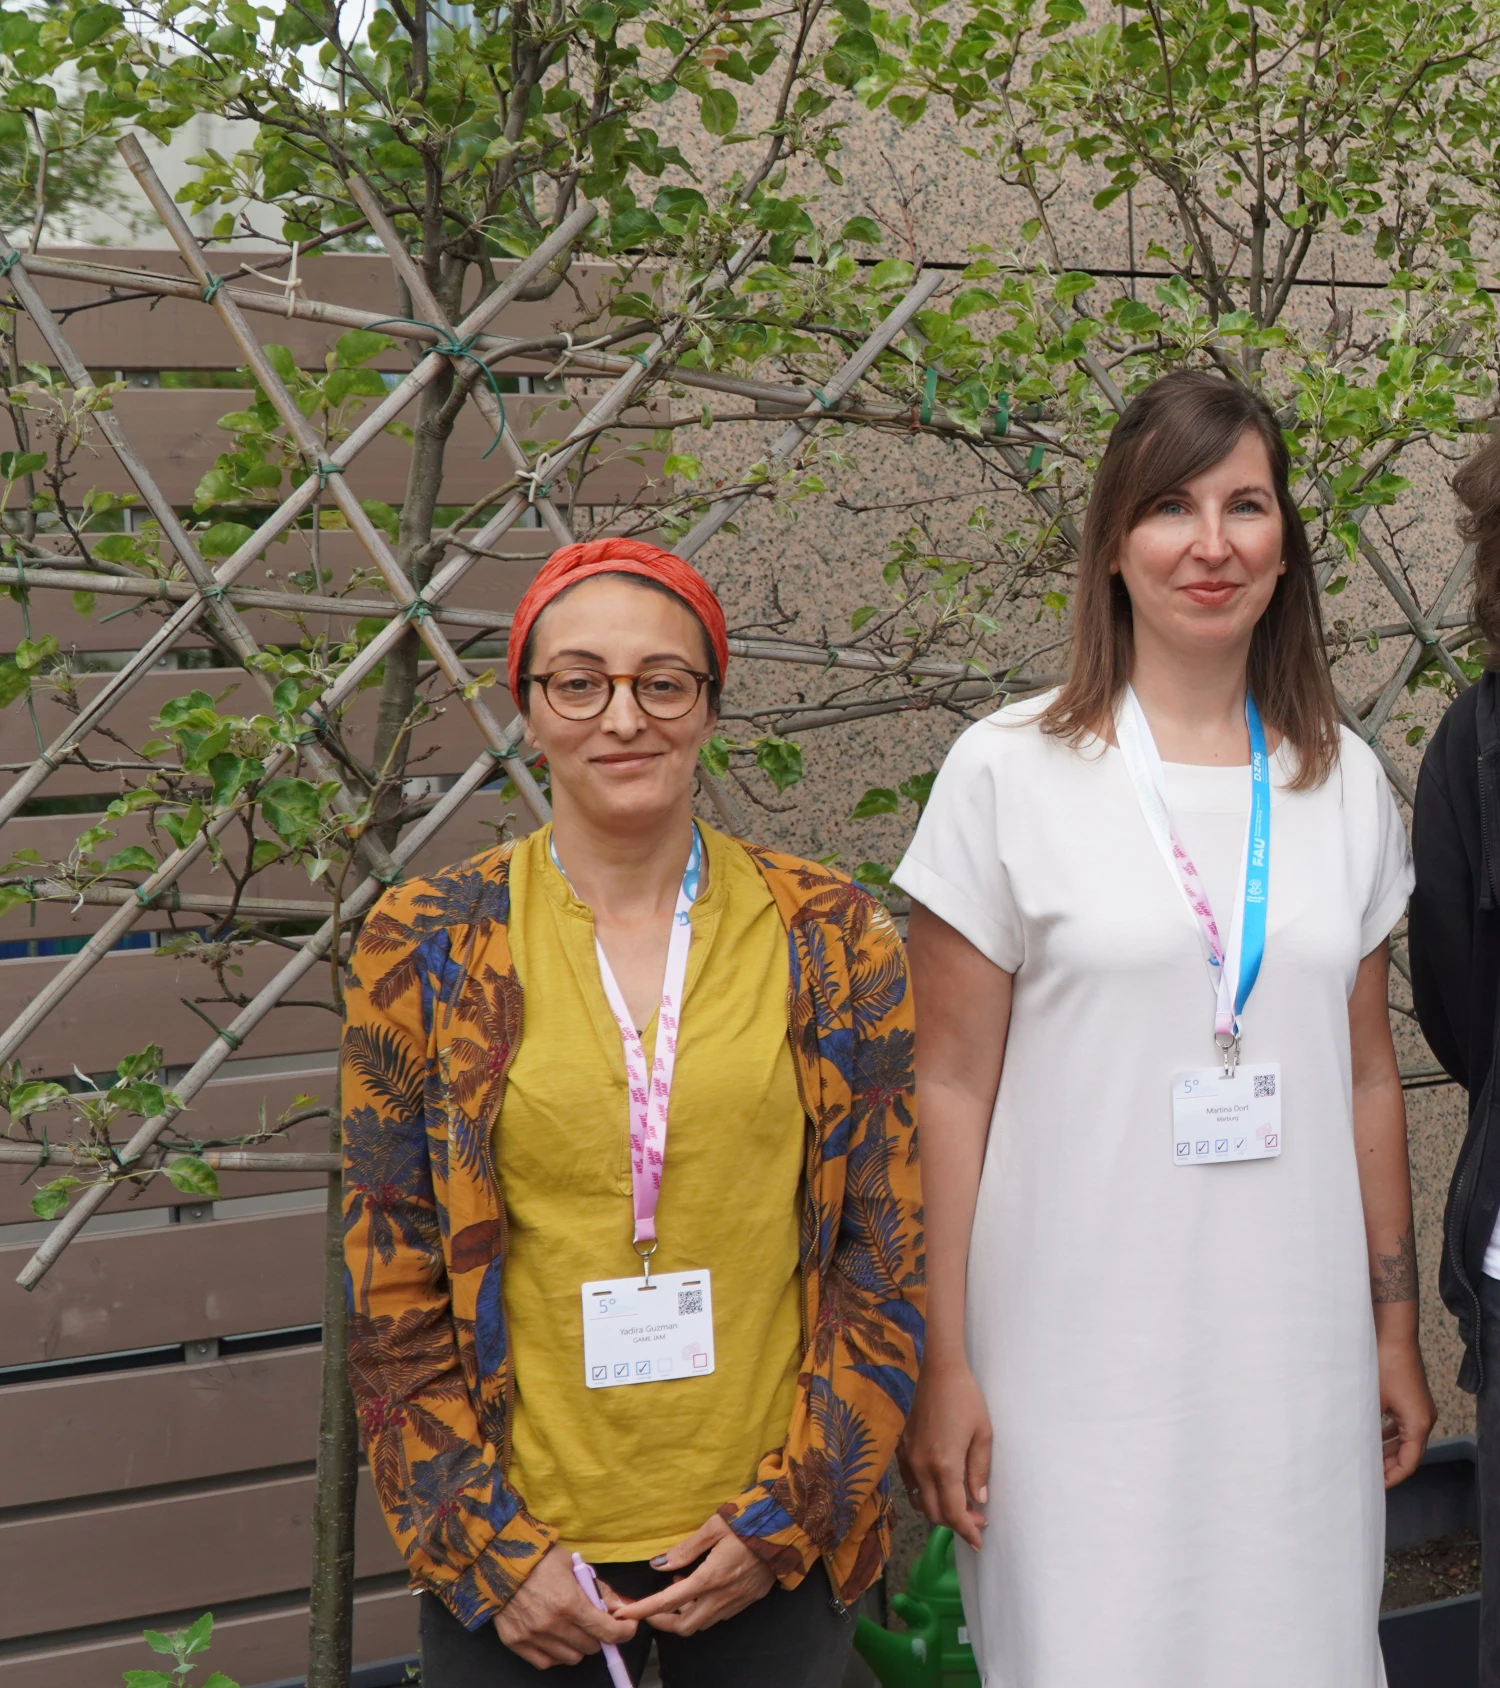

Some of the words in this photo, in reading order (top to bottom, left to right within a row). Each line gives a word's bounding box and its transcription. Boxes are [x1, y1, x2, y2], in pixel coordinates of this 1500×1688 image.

[1253, 752, 1262, 782] DZPG
[1252, 838, 1265, 867] FAU
[1206, 1106, 1232, 1115] Martina
[619, 1326, 644, 1336] Yadira
[645, 1322, 678, 1333] Guzman
